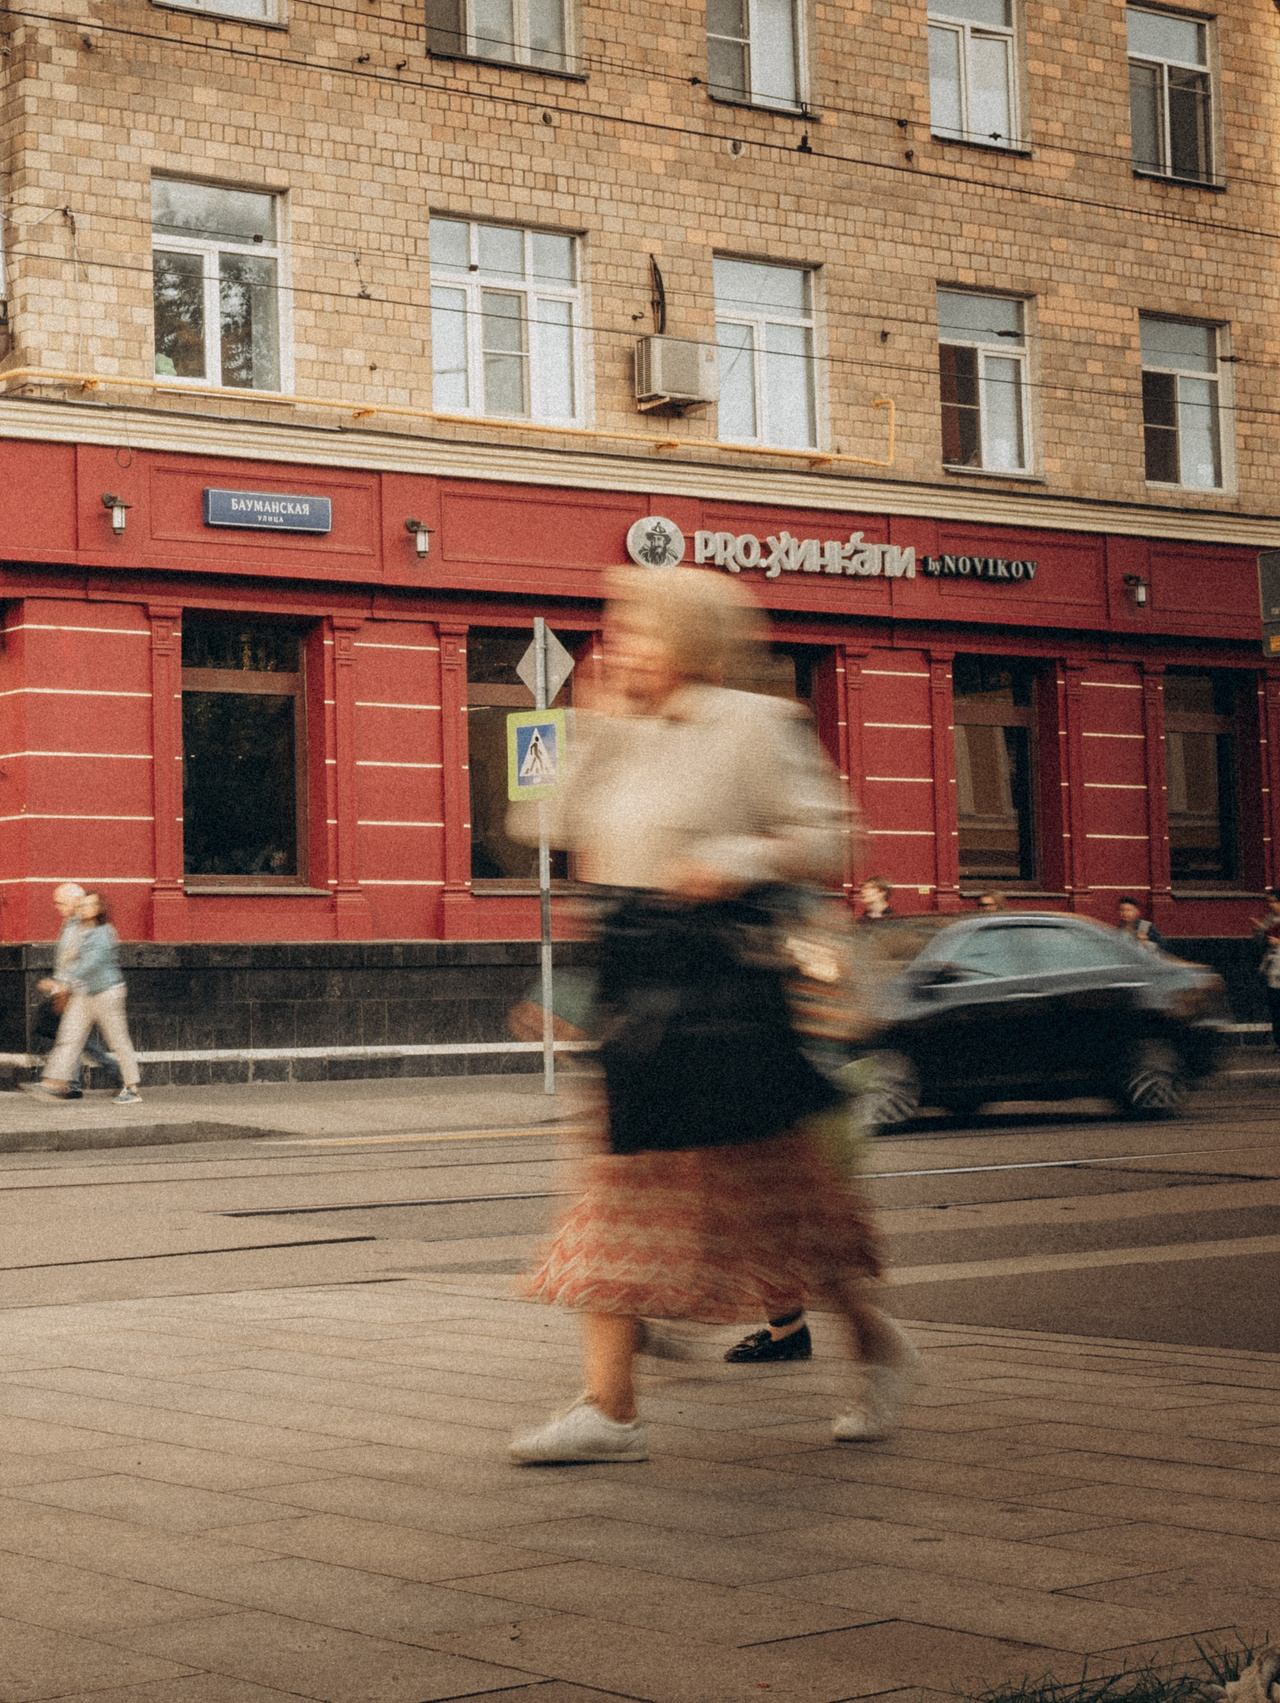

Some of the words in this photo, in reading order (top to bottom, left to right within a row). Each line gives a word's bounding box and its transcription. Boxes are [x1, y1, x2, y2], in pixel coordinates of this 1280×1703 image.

[231, 498, 310, 515] БАУМАНСКАЯ
[928, 557, 941, 575] by
[943, 555, 1038, 579] NOVIKOV
